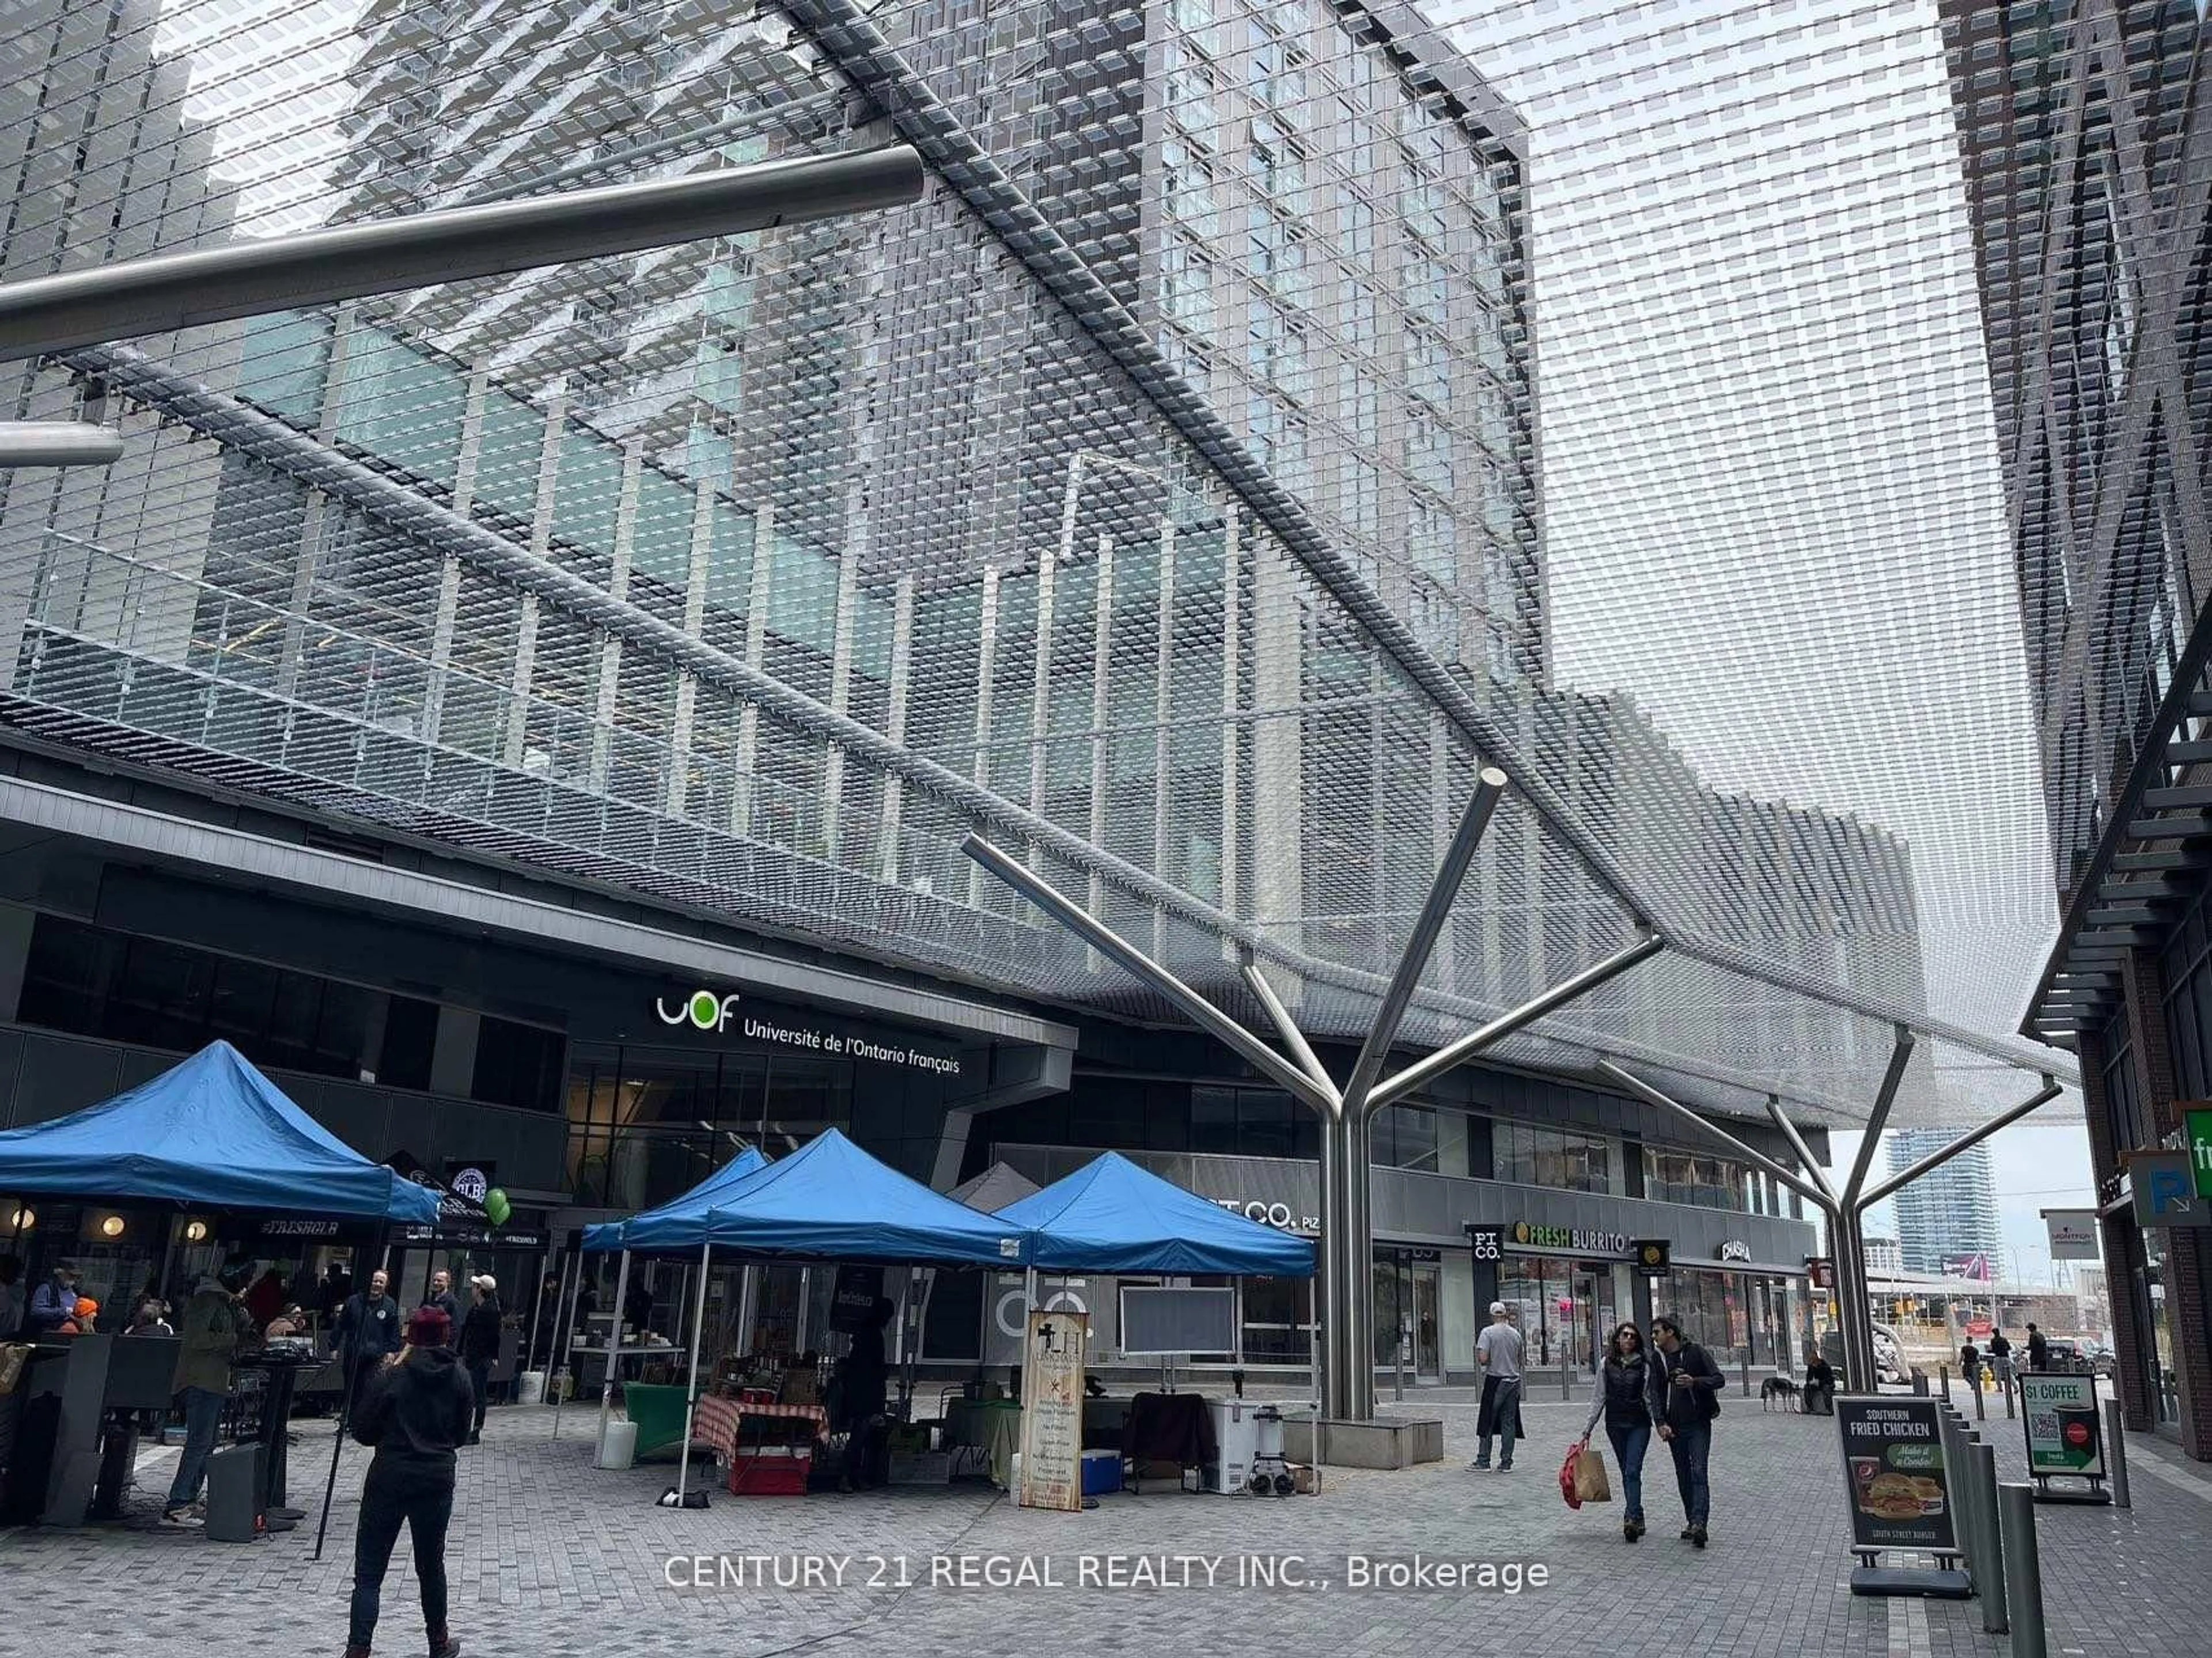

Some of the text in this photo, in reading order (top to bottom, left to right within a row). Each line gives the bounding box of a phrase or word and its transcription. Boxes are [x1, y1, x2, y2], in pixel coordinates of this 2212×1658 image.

[745, 1019, 960, 1075] Université de l'Ontario français
[1475, 1233, 1496, 1245] PI
[1529, 1224, 1570, 1247] FRESH
[1572, 1229, 1624, 1251] BURRITO
[1475, 1246, 1500, 1259] CO.
[2041, 1384, 2080, 1399] COFFEE
[1866, 1409, 1910, 1421] SOUTHERN
[1850, 1422, 1930, 1436] FRIED CHICKEN
